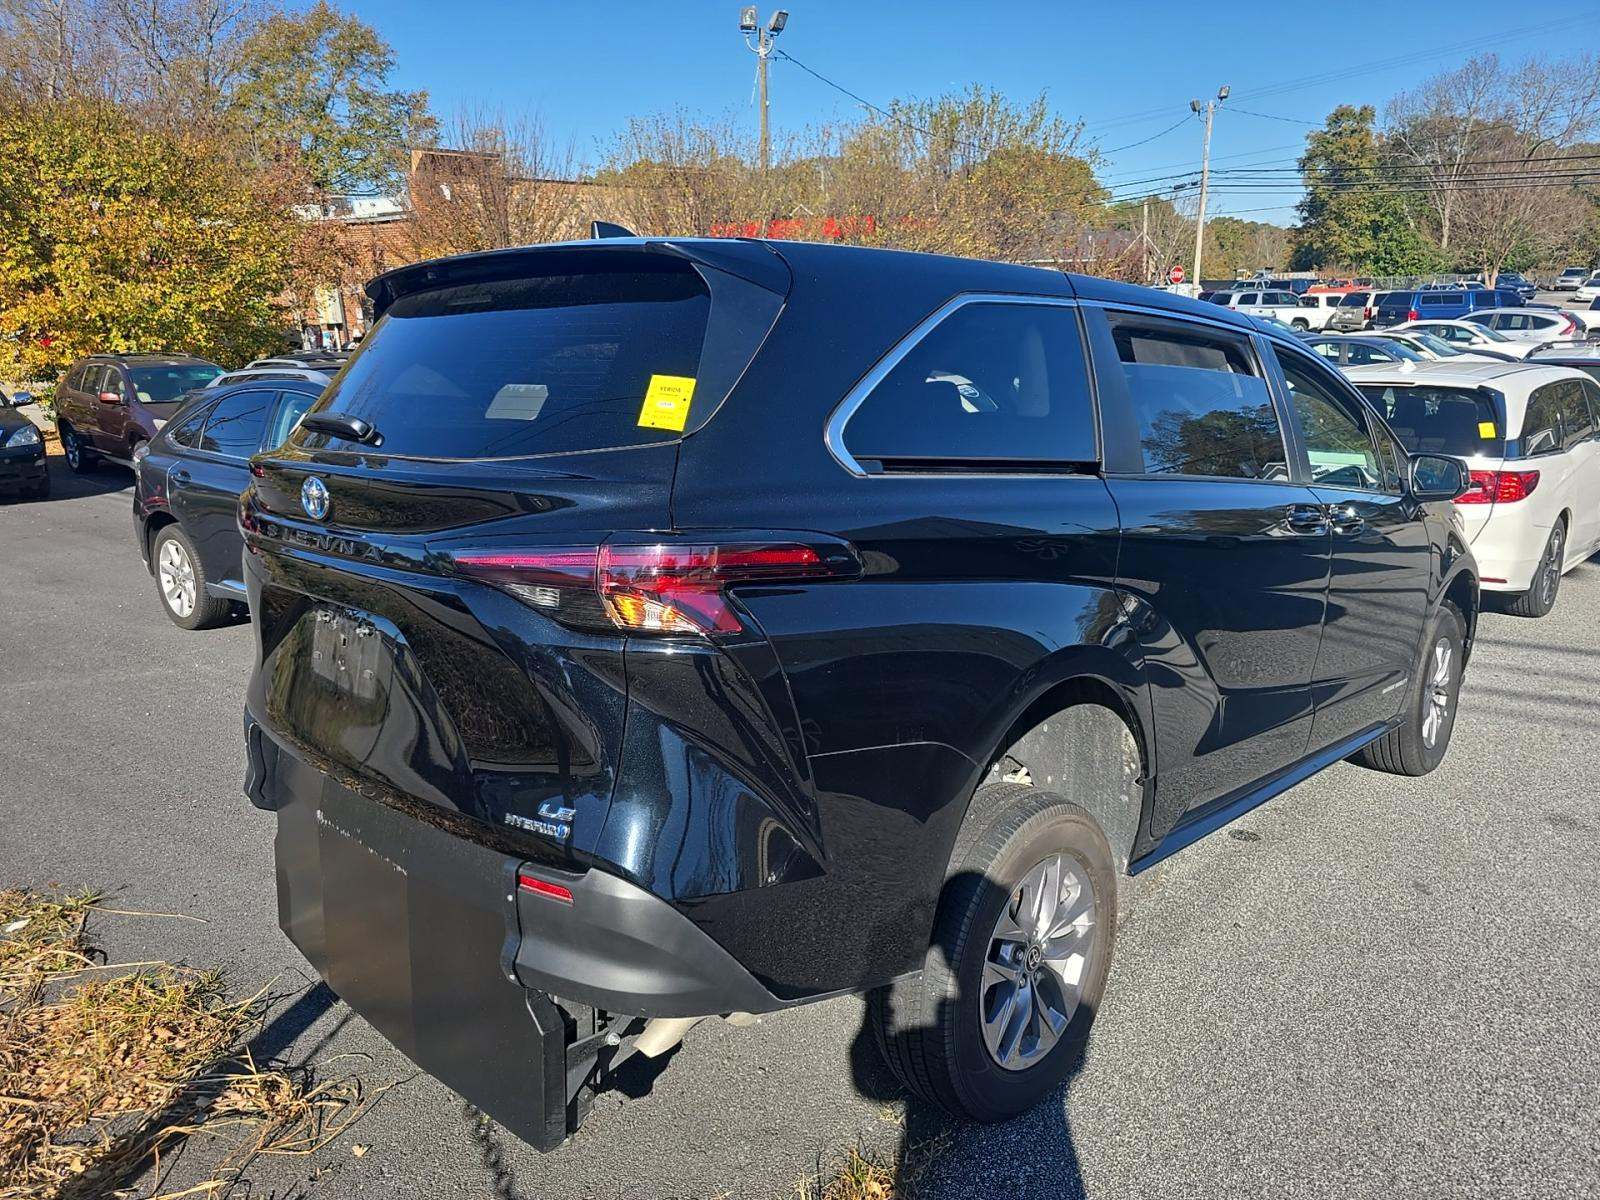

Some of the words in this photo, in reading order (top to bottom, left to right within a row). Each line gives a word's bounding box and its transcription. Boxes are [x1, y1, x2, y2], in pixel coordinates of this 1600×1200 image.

[266, 524, 385, 563] SIENNA
[504, 812, 558, 836] HYBRID
[538, 803, 577, 821] LE
